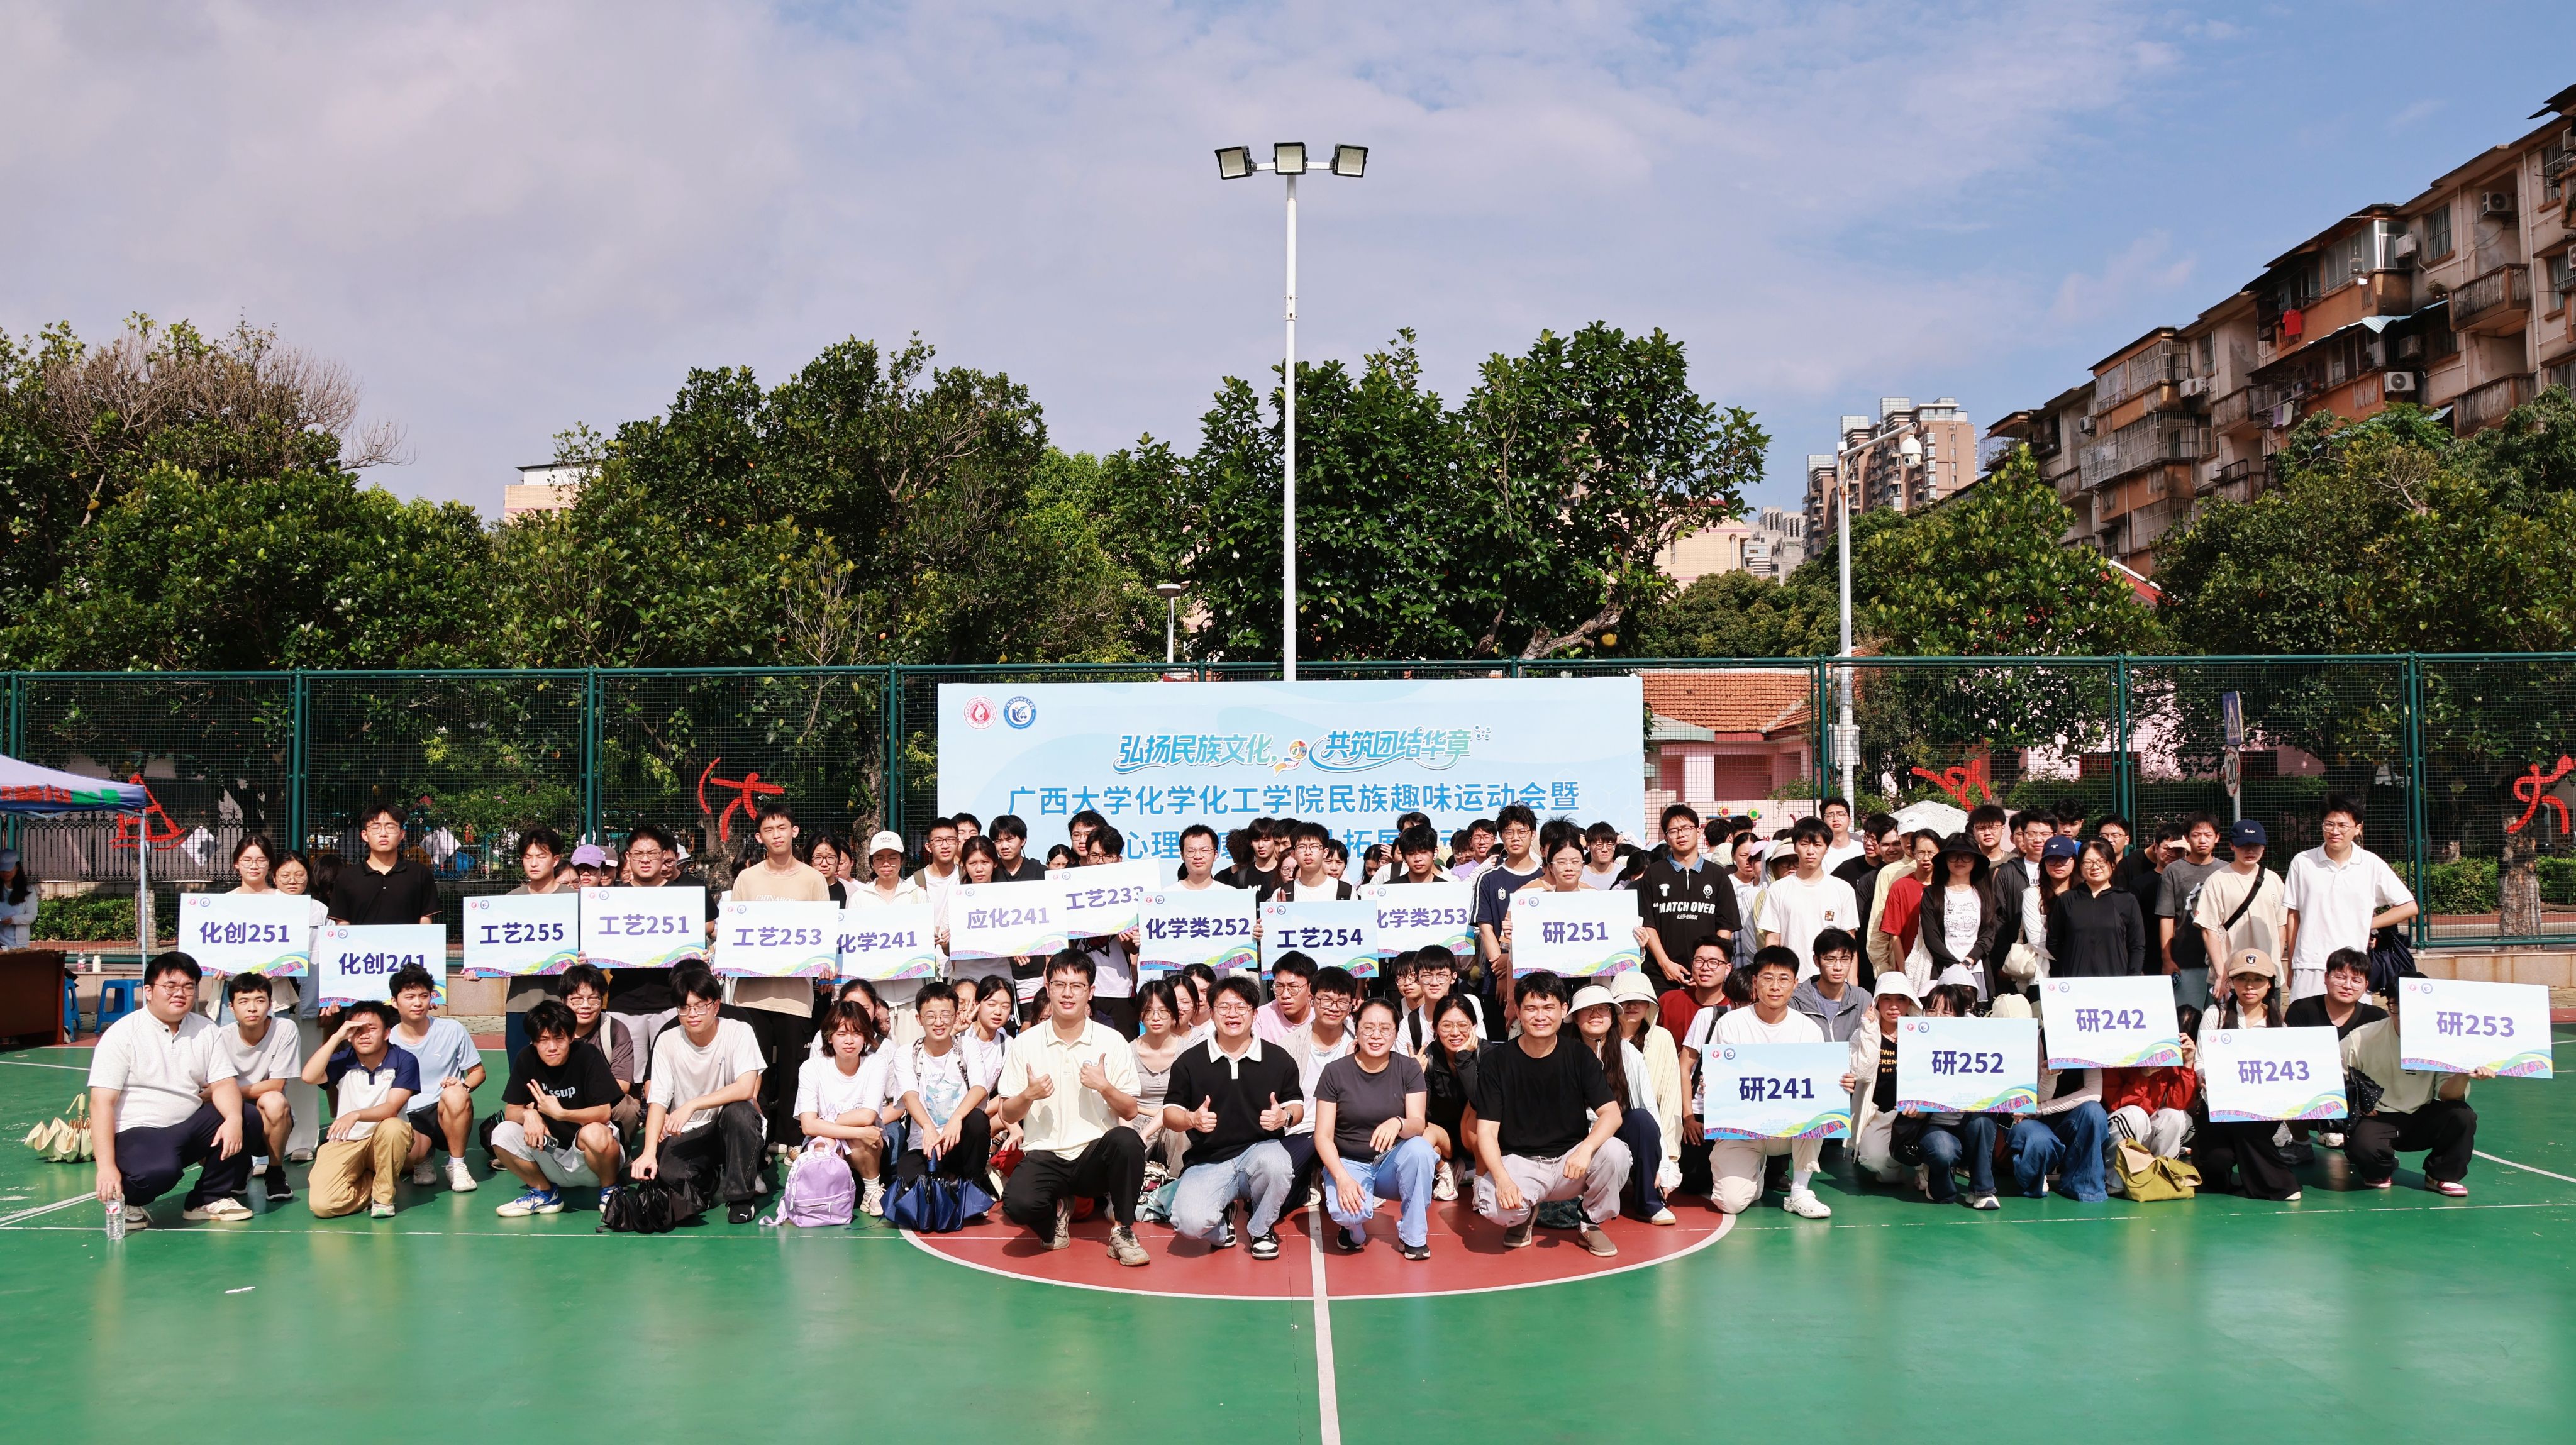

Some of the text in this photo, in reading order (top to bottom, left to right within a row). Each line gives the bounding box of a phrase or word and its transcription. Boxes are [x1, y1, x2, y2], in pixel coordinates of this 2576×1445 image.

[1313, 728, 1473, 768] 共筑团结华章
[2227, 758, 2236, 785] 20
[1008, 782, 1579, 816] 广西大学化学化工学院民族趣味运动会暨
[1066, 886, 1144, 910] 工艺233
[1690, 902, 1716, 914] OVER
[599, 914, 689, 936] 工艺251
[967, 907, 1050, 929] 应化241
[1146, 917, 1250, 939] 化学类252
[199, 921, 290, 944] 化创251
[480, 922, 564, 944] 工艺255
[733, 926, 821, 946] 工艺253
[836, 931, 917, 954] 化学241
[1277, 927, 1363, 948] 工艺254
[1543, 921, 1609, 944] 研251
[2075, 1009, 2146, 1033] 研242
[2436, 1011, 2514, 1038] 研253
[1932, 1050, 2004, 1075] 研252
[2237, 1060, 2310, 1084] 研243
[1740, 1077, 1815, 1102] 研241
